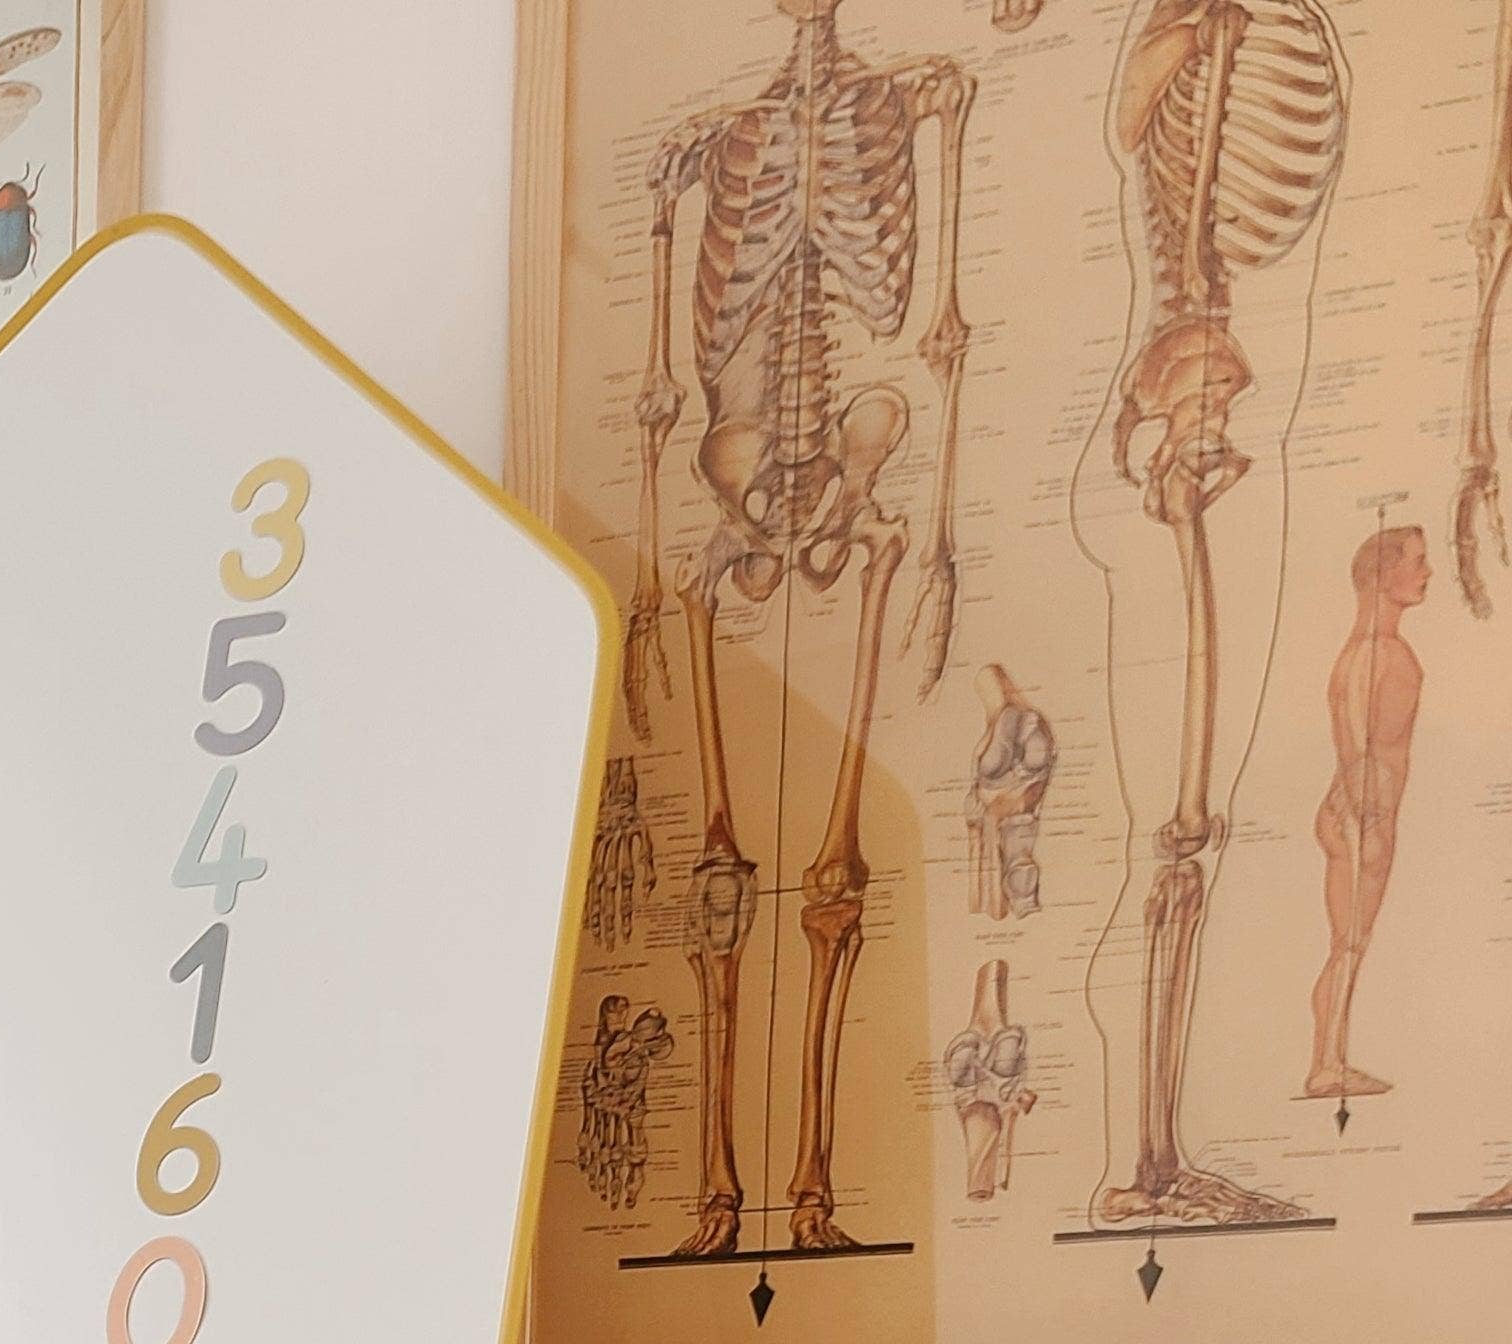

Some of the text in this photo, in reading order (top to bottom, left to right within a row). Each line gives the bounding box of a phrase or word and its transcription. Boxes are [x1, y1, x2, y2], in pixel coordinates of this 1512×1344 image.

[219, 458, 310, 601] 3
[194, 611, 287, 756] 5
[172, 765, 267, 914] 4
[169, 922, 229, 1064] 1
[137, 1073, 221, 1216] 6
